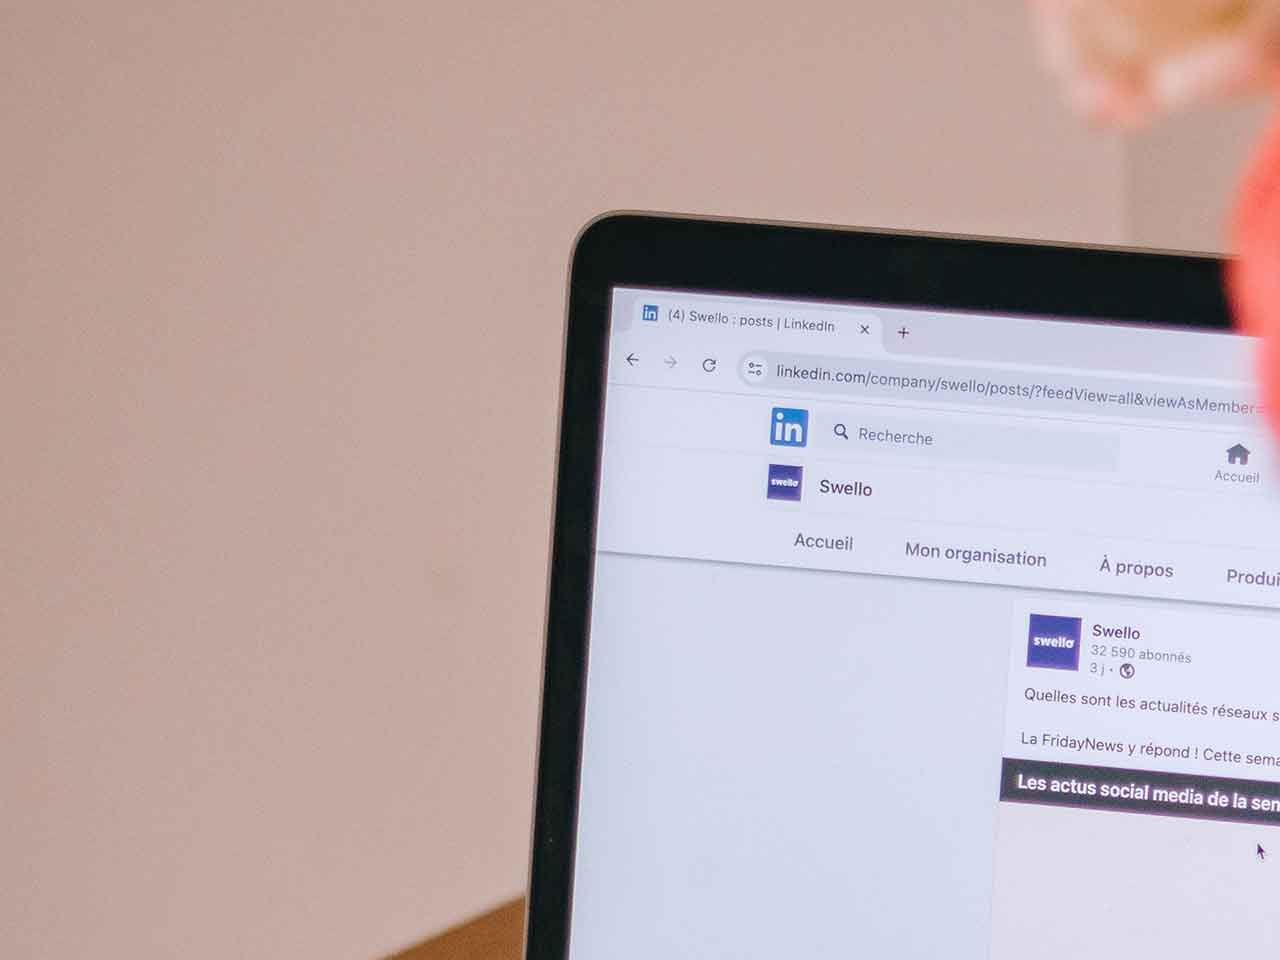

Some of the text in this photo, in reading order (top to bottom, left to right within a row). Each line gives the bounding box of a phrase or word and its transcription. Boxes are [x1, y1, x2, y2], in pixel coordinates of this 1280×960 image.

[669, 311, 835, 332] (4) Swello posts LinkedIn
[775, 413, 803, 442] in
[859, 428, 933, 445] Recherche
[1214, 470, 1260, 484] Accueil
[819, 479, 873, 497] Swello
[794, 533, 853, 552] Accueil
[906, 542, 1047, 568] Mon organisation
[1099, 554, 1174, 578] À propos
[1092, 624, 1140, 641] Swello
[1033, 636, 1074, 649] swello
[1091, 645, 1191, 664] 32 590 abonnés
[1090, 663, 1097, 674] 3
[1024, 688, 1077, 704] Quelles
[1081, 694, 1111, 708] sont
[1116, 695, 1135, 710] les
[1140, 698, 1208, 715] actualités
[1212, 703, 1267, 721] réseaux
[1022, 733, 1037, 745] La
[1042, 734, 1123, 754] FridayNews
[1128, 743, 1136, 756] y
[1140, 743, 1190, 760] répond
[1203, 748, 1242, 764] Cette
[1017, 774, 1047, 791] Les
[1050, 780, 1096, 795] actus
[1100, 783, 1149, 800] social
[1153, 788, 1203, 805] media
[1207, 792, 1229, 807] de
[1233, 792, 1247, 809] la
